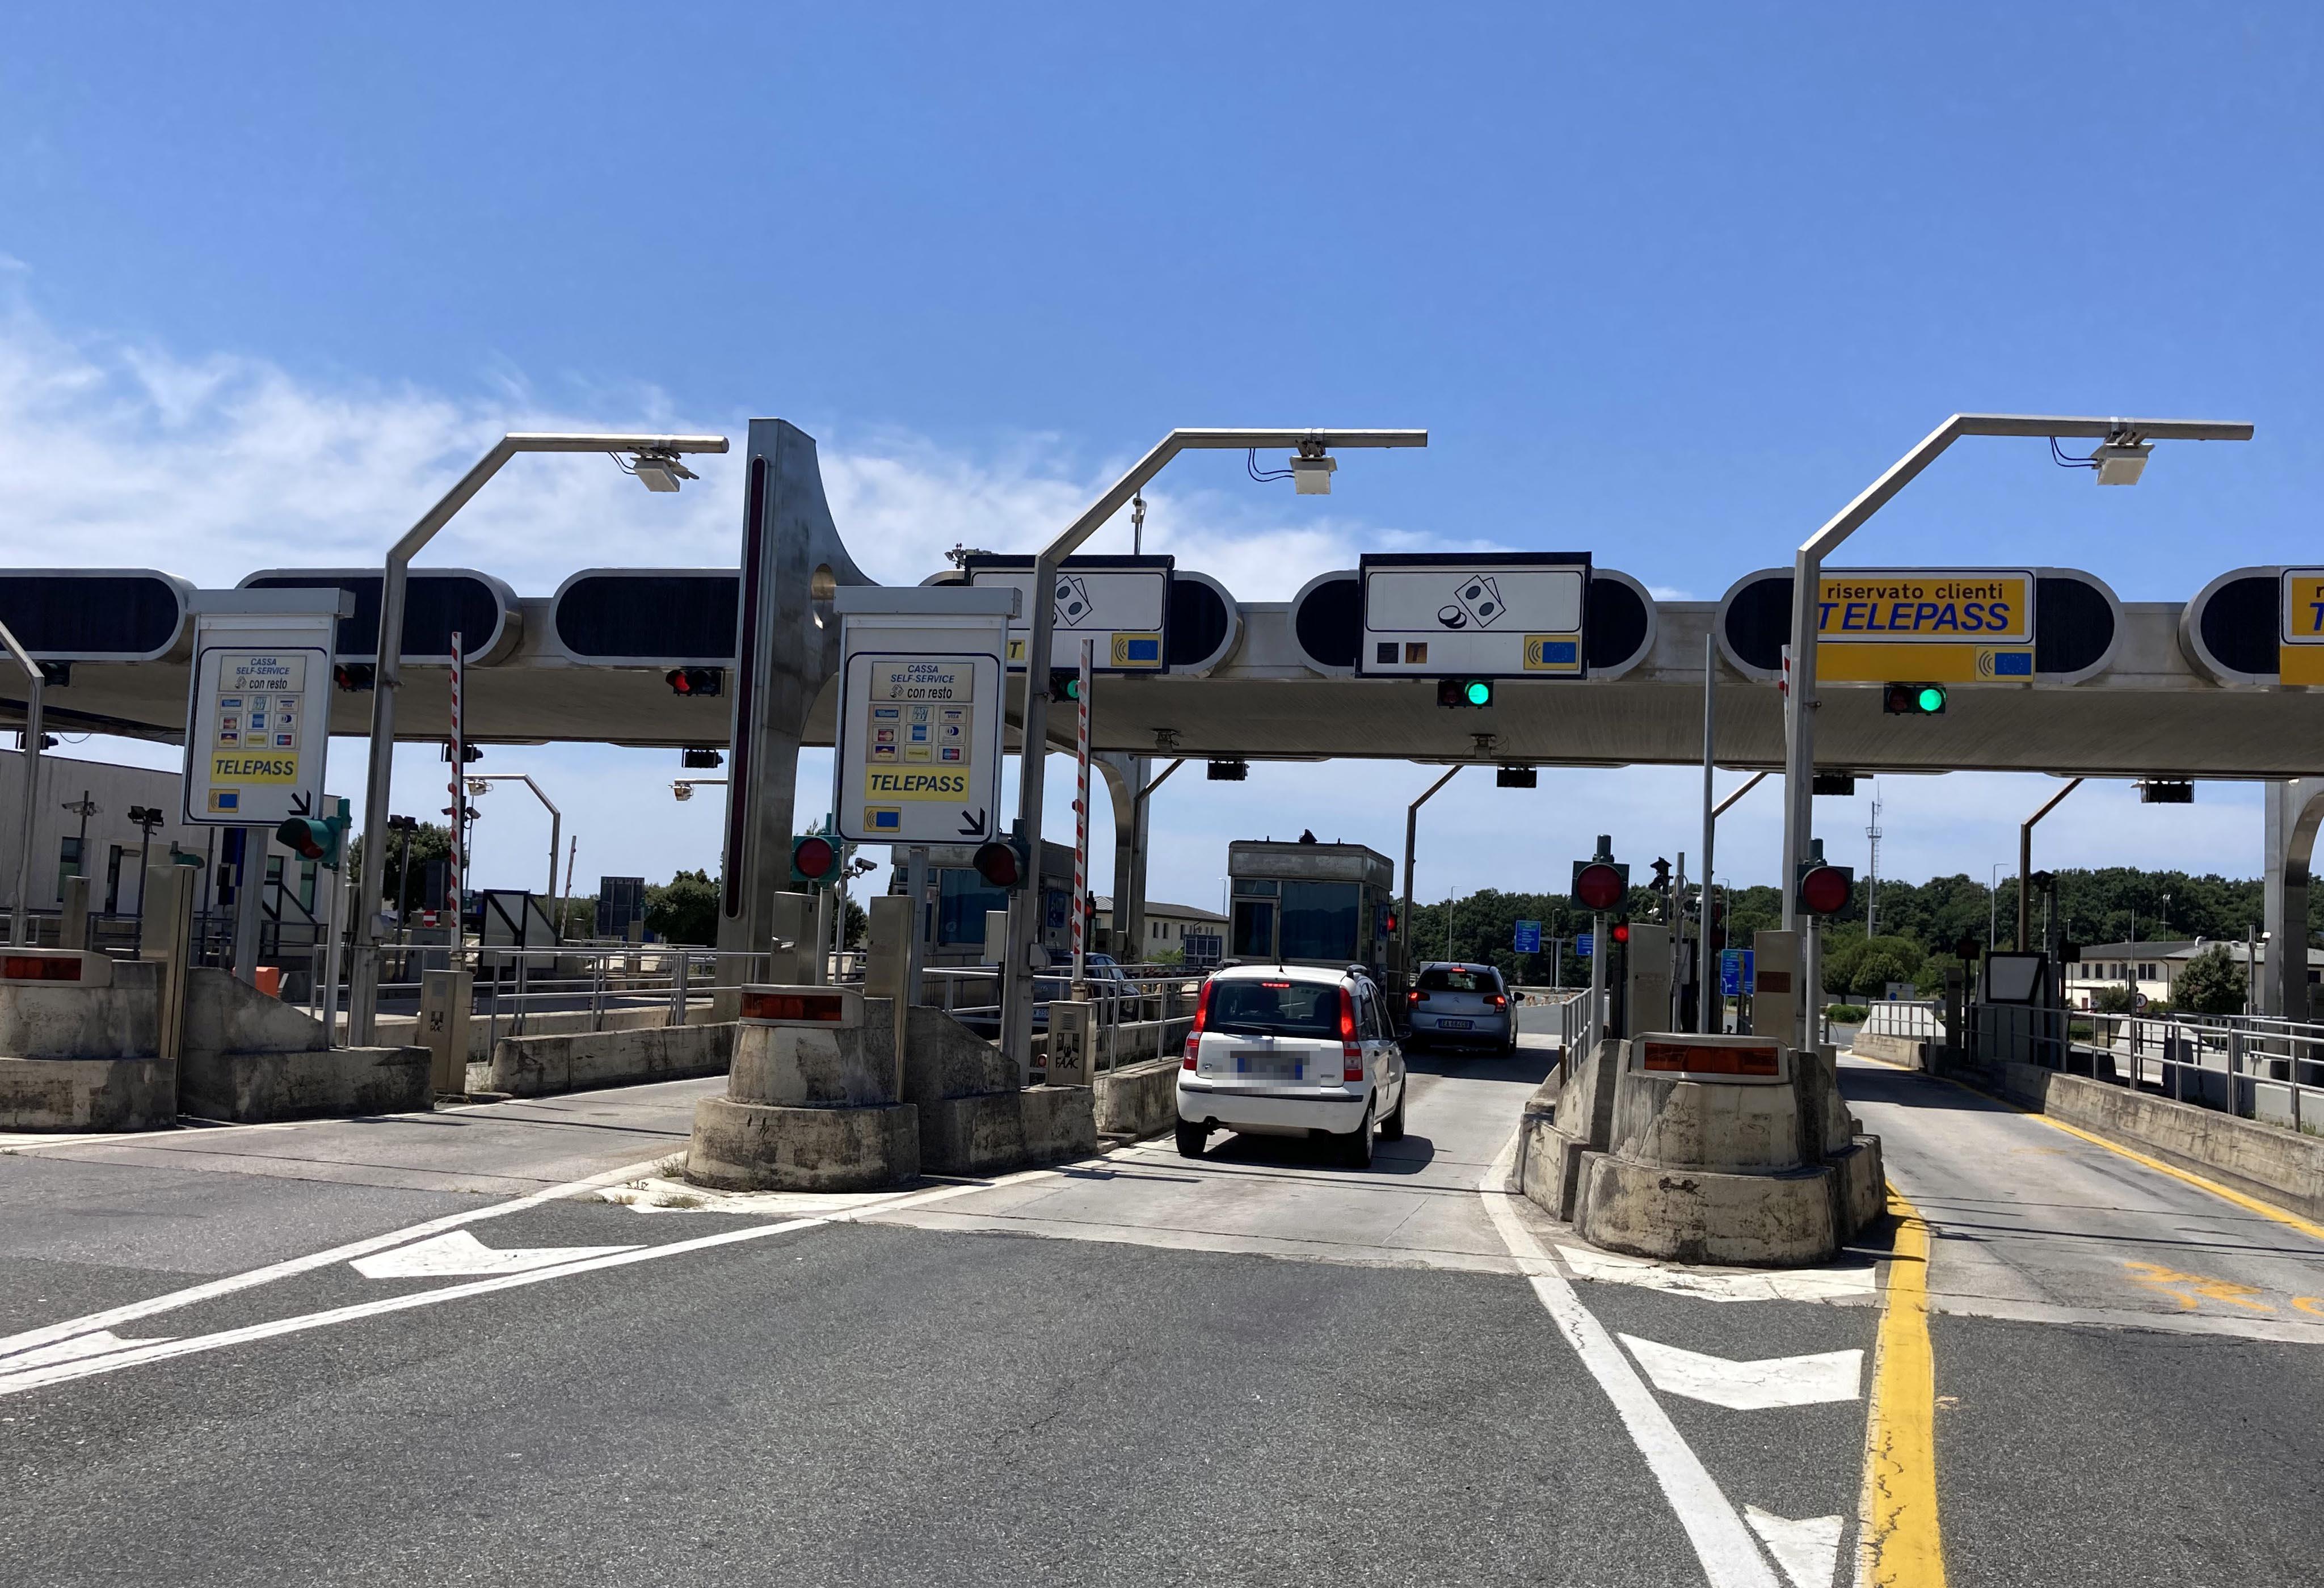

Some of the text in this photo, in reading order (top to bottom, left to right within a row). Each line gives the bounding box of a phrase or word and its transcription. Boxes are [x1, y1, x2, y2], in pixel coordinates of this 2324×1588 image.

[1827, 583, 2003, 599] riservato clienti
[1818, 603, 2010, 631] TELEPASS
[235, 667, 290, 675] SELF-SERVICE
[907, 664, 938, 673] CASSA
[249, 677, 288, 689] con resto
[890, 674, 955, 684] SELF-SERVICE
[907, 686, 953, 699] con resto
[216, 759, 294, 776] TELEPASS
[871, 774, 965, 793] TELEPASS
[1055, 1056, 1079, 1069] FAAC
